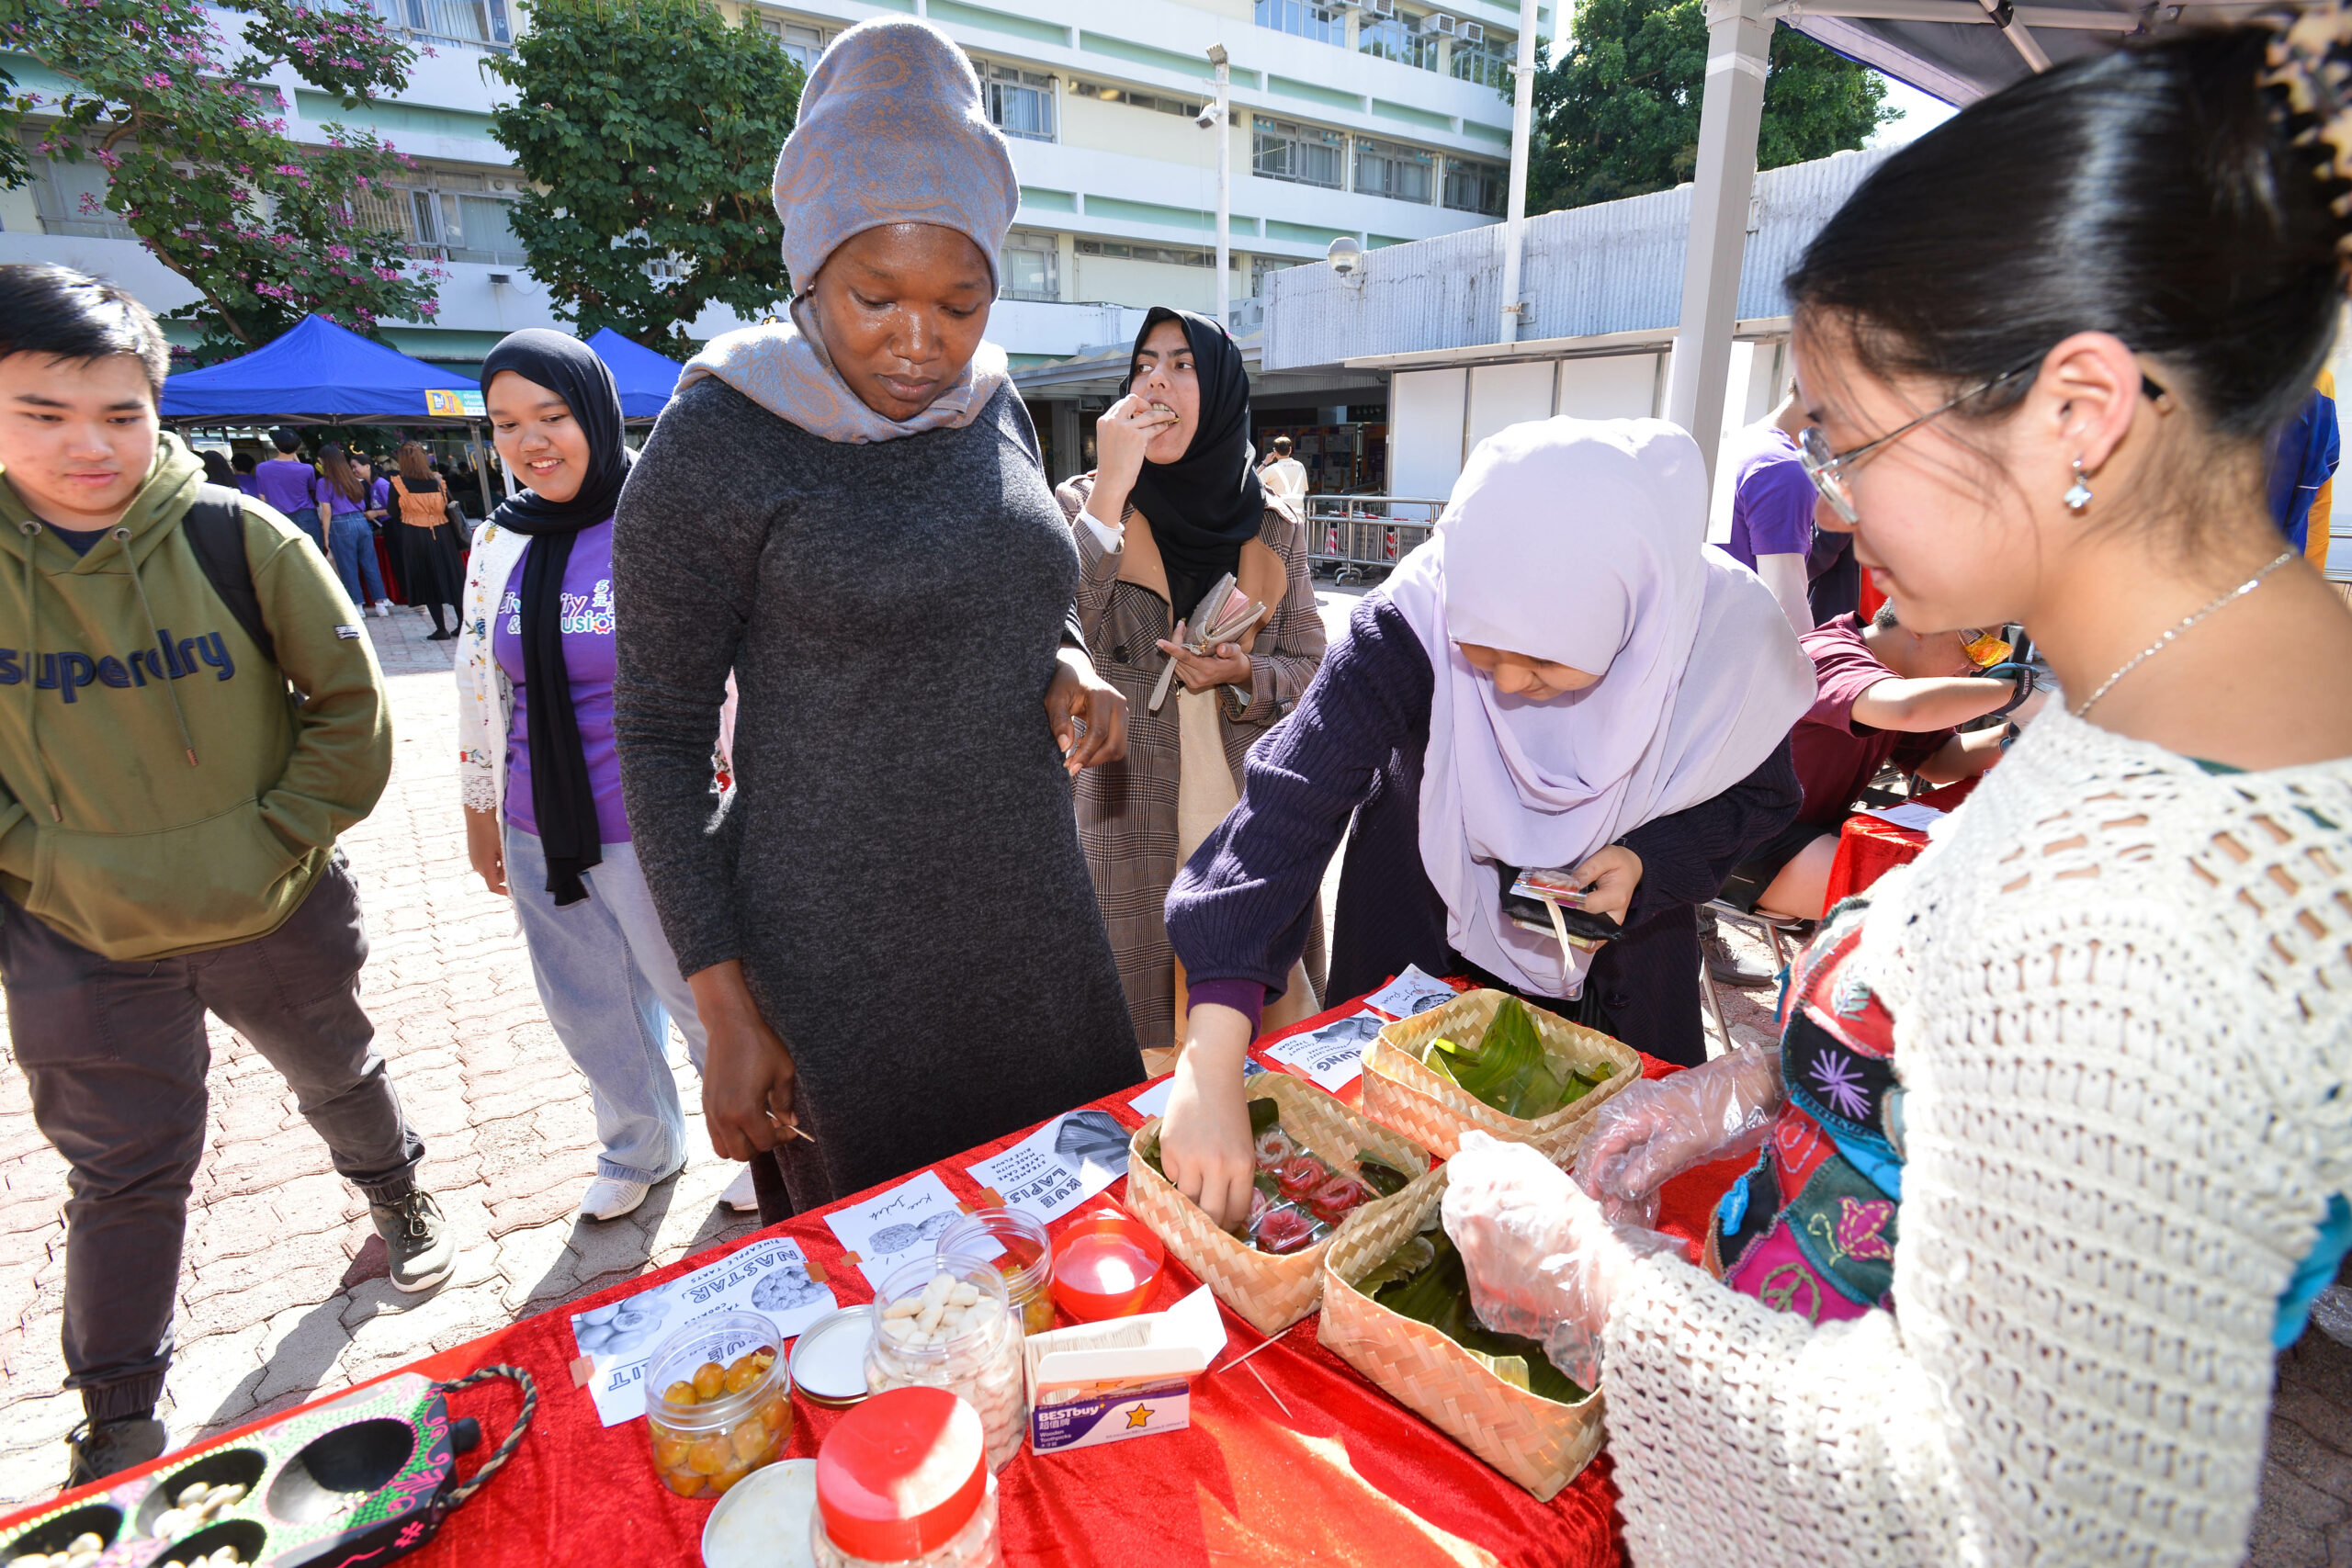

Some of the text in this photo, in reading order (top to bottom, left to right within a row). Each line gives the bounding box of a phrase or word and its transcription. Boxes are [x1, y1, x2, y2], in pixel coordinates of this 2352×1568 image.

[0, 629, 235, 704] superdry
[1317, 1050, 1362, 1071] LUNG
[1010, 1160, 1046, 1182] STEAMED
[1010, 1168, 1067, 1203] LAPIS
[1040, 1178, 1082, 1208] KUE
[690, 1249, 798, 1303] NASTAR
[691, 1239, 780, 1284] PINEAPPLE TARTS
[1038, 1405, 1100, 1422] BESTbuy
[1040, 1429, 1065, 1438] Wooden
